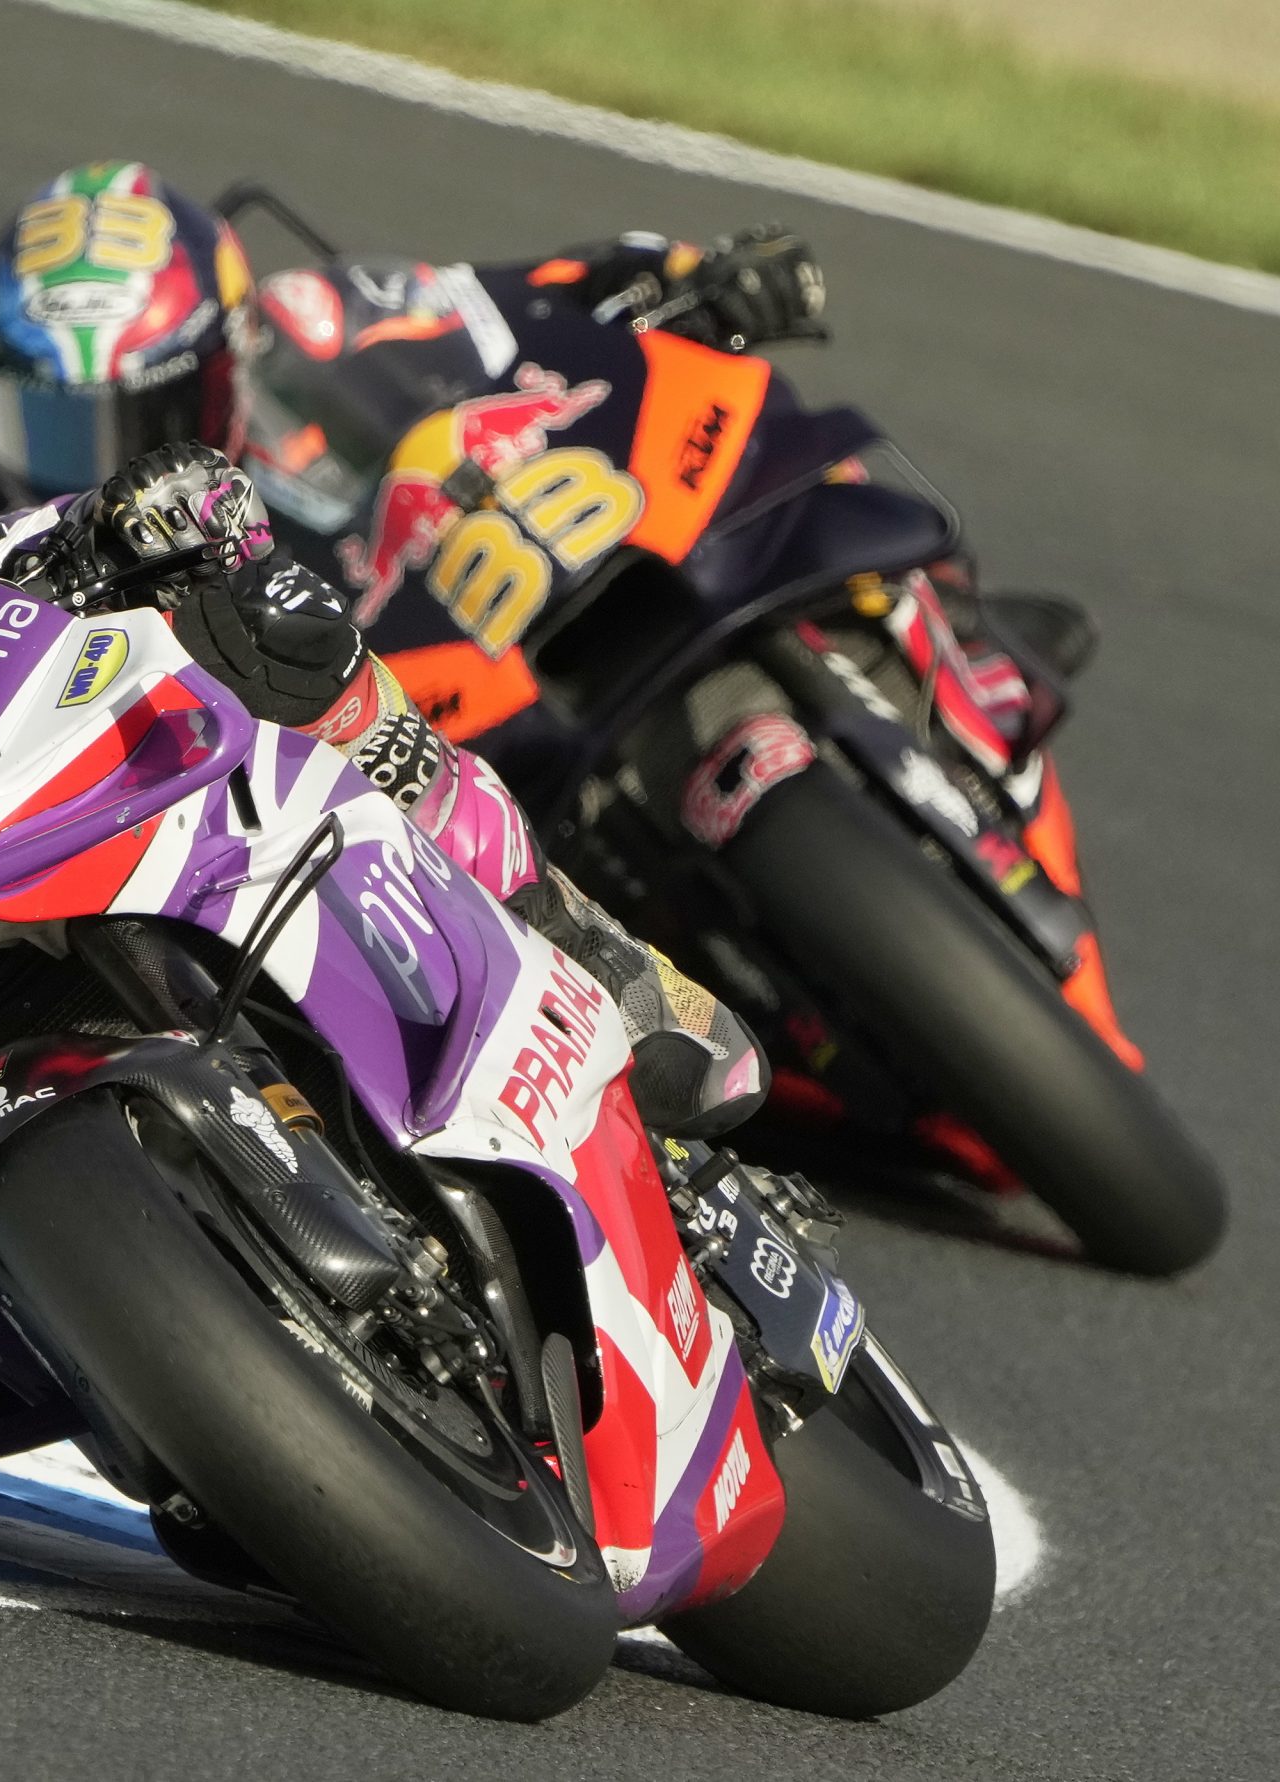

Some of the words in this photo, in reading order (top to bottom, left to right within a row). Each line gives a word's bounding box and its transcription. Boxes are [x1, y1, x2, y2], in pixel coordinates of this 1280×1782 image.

[14, 192, 176, 276] 33
[426, 447, 646, 661] 33
[65, 634, 116, 701] WD-40
[369, 712, 421, 788] OCIAL
[393, 722, 440, 811] OCIA
[498, 947, 603, 1152] PRAMAC
[713, 1426, 752, 1534] MOTUL
